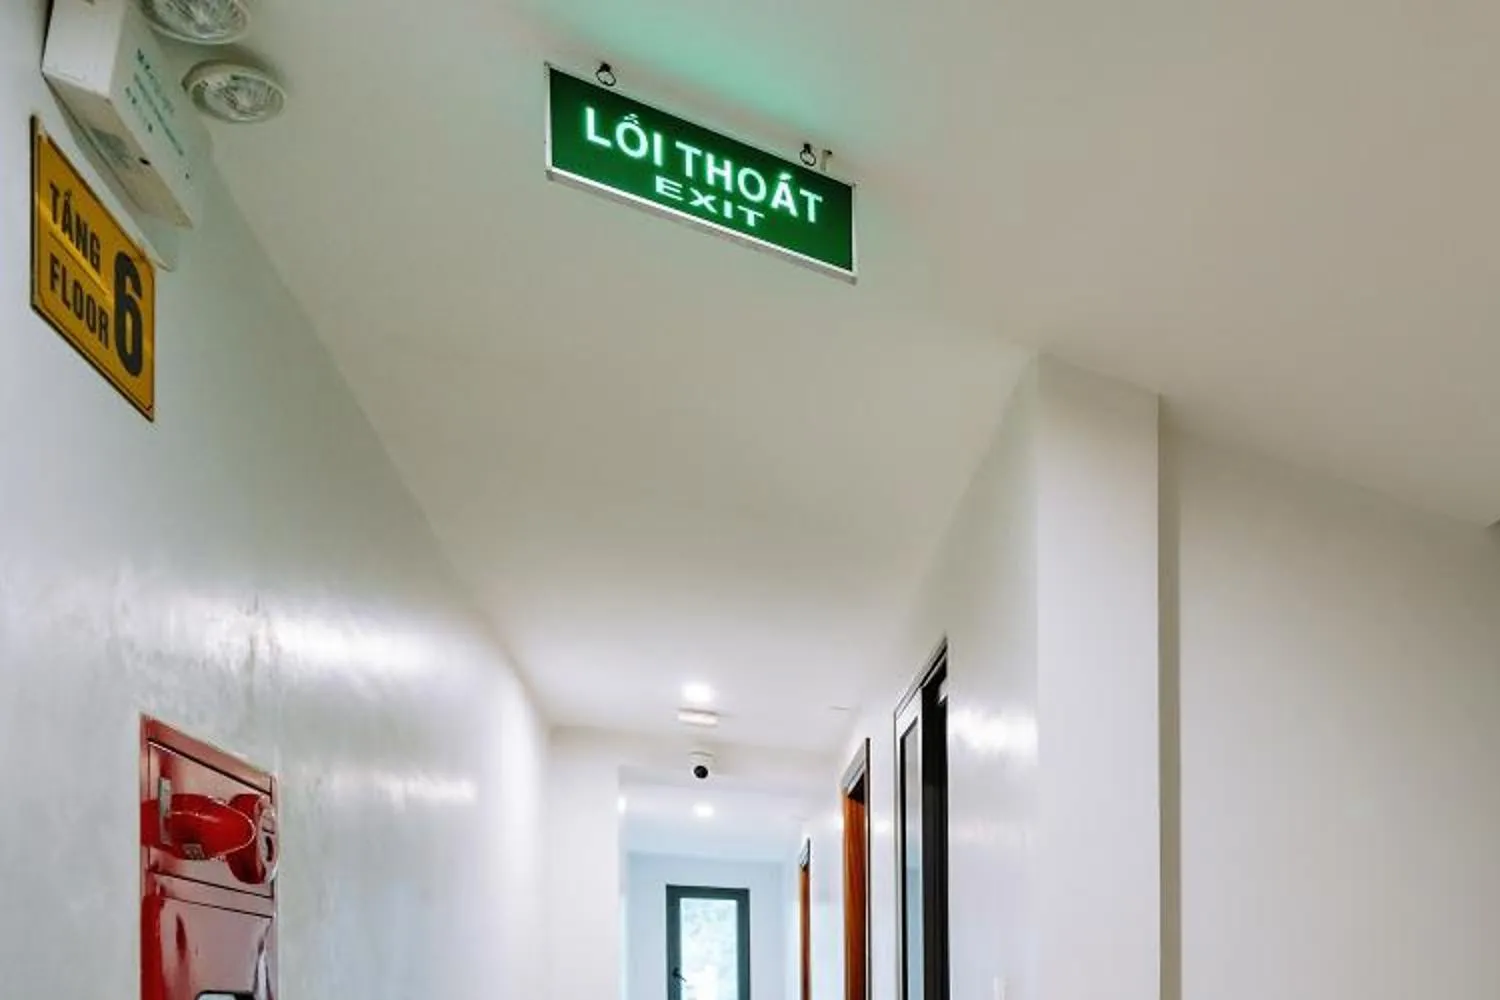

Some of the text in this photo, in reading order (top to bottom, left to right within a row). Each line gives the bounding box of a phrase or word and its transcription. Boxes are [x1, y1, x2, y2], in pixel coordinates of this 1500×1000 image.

[585, 106, 823, 223] LỐI THOÁT
[655, 175, 764, 227] EXIT
[49, 252, 109, 350] FLOOR
[114, 251, 143, 377] 6
